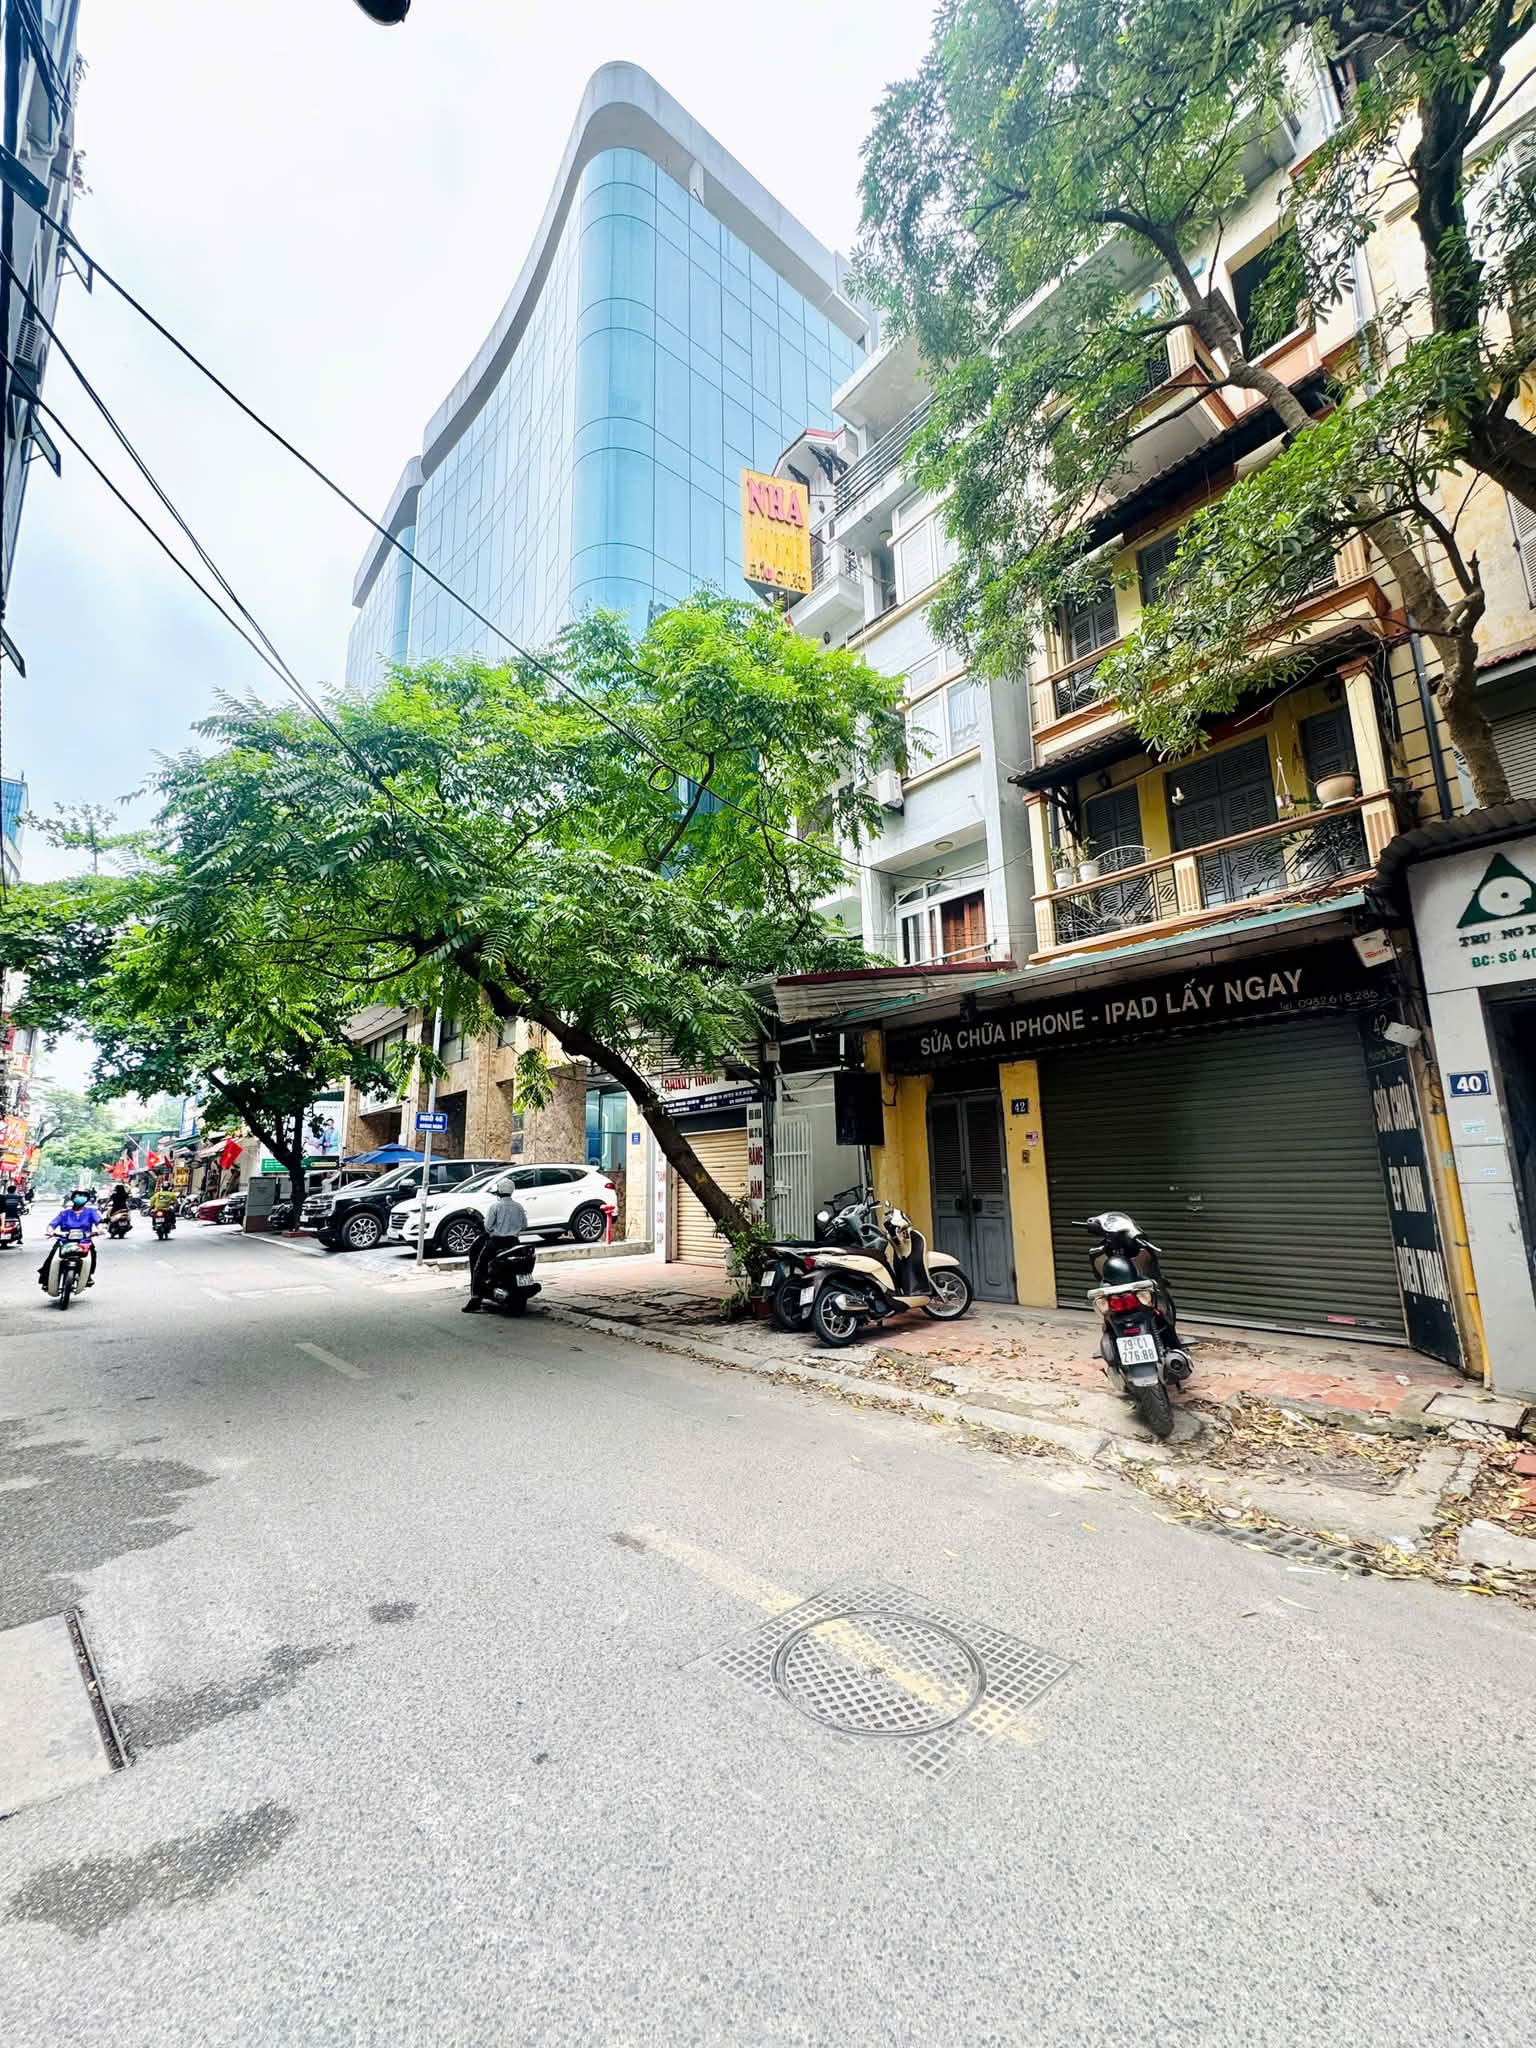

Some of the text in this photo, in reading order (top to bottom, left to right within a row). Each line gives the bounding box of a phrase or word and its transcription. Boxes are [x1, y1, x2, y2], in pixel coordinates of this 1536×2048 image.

[920, 1029, 952, 1056] SỬA
[957, 1021, 1006, 1049] CHỮA
[1011, 1009, 1085, 1041] IPHONE
[1105, 996, 1157, 1025] IPAD
[1165, 978, 1215, 1014] LẤY
[1224, 968, 1302, 1004] NGAY
[1456, 1075, 1482, 1092] 40
[1014, 1101, 1026, 1113] 42
